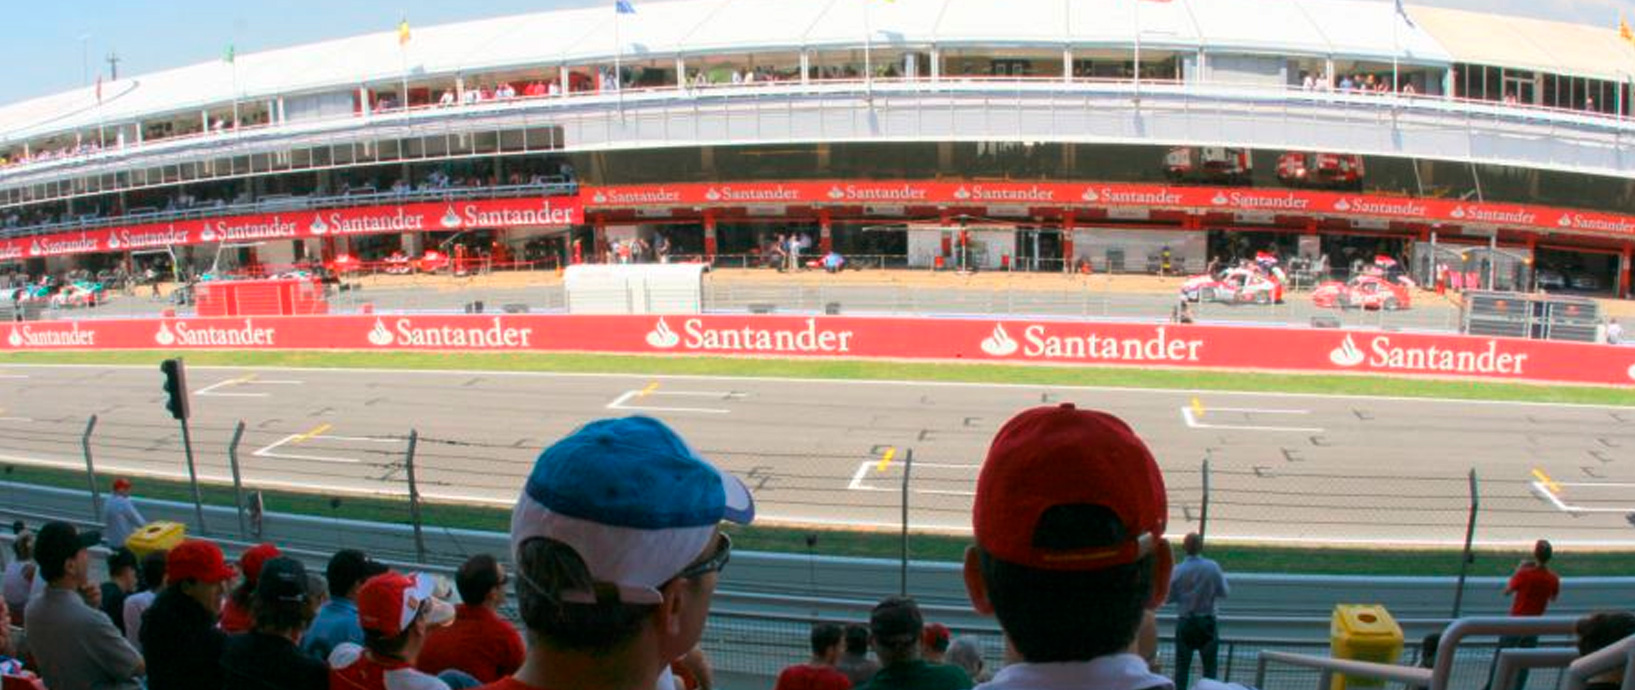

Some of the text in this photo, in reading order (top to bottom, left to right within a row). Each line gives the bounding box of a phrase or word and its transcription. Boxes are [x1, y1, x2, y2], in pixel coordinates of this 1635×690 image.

[608, 189, 680, 202] Santander
[722, 186, 799, 199] Santander
[846, 185, 928, 199] Santander
[972, 184, 1054, 200] Santander
[1100, 187, 1182, 203] Santander
[1229, 190, 1310, 209] Santander
[464, 201, 573, 226] Santander
[1351, 198, 1427, 216] Santander
[1466, 205, 1537, 224] Santander
[216, 215, 298, 239] Santander
[330, 209, 424, 233] Santander
[1571, 213, 1635, 231] Santander
[41, 237, 98, 254] Santander
[119, 225, 189, 247] Santander
[22, 324, 95, 345] Santander
[174, 322, 275, 345] Santander
[396, 316, 532, 347] Santander
[683, 315, 853, 352] Santander
[1023, 322, 1204, 362] Santander
[1369, 334, 1529, 375] Santander
